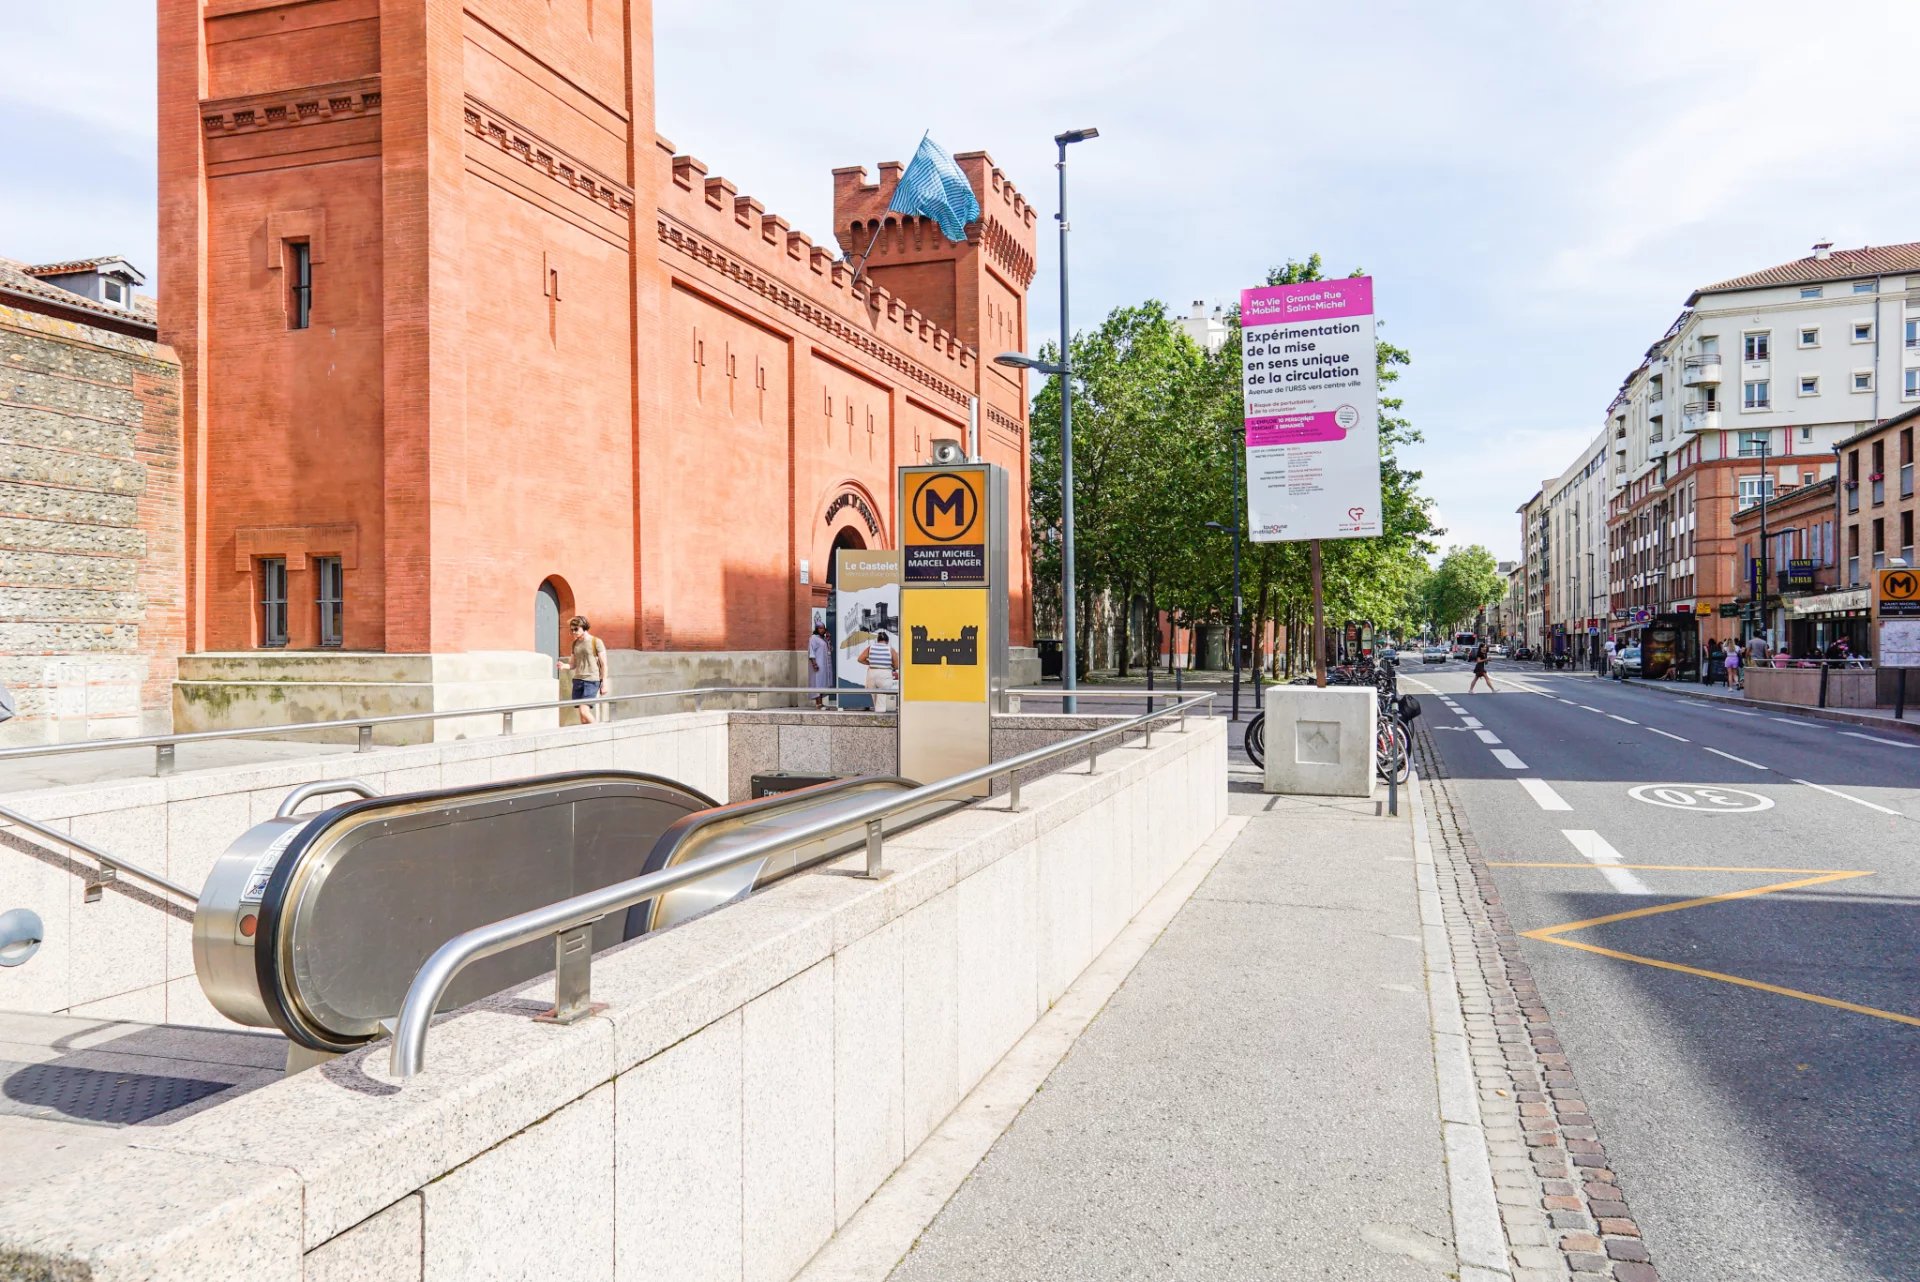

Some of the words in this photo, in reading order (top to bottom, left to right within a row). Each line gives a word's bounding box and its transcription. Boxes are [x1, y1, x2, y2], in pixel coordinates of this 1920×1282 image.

[1286, 293, 1321, 303] Grande
[1324, 291, 1341, 300] Rue
[1252, 306, 1280, 315] Mobile
[1287, 300, 1346, 312] Saint-Michel
[1247, 323, 1360, 343] Expérimentation
[1247, 346, 1264, 356] de
[1268, 344, 1280, 355] la
[1285, 342, 1316, 353] mise
[1248, 362, 1264, 370] en
[1268, 359, 1298, 369] sens
[1302, 354, 1350, 366] unique
[1248, 374, 1265, 385] de
[1269, 372, 1282, 383] la
[1286, 366, 1359, 382] circulation
[1248, 387, 1273, 395] Avenue
[1285, 384, 1307, 392] l'URSS
[926, 489, 964, 526] M
[942, 550, 976, 558] MICHEL
[845, 562, 856, 570] Le
[859, 562, 898, 570] Castelet
[946, 559, 982, 567] LANGER
[941, 571, 949, 580] B
[1890, 576, 1910, 593] M
[1653, 789, 1744, 806] 30
